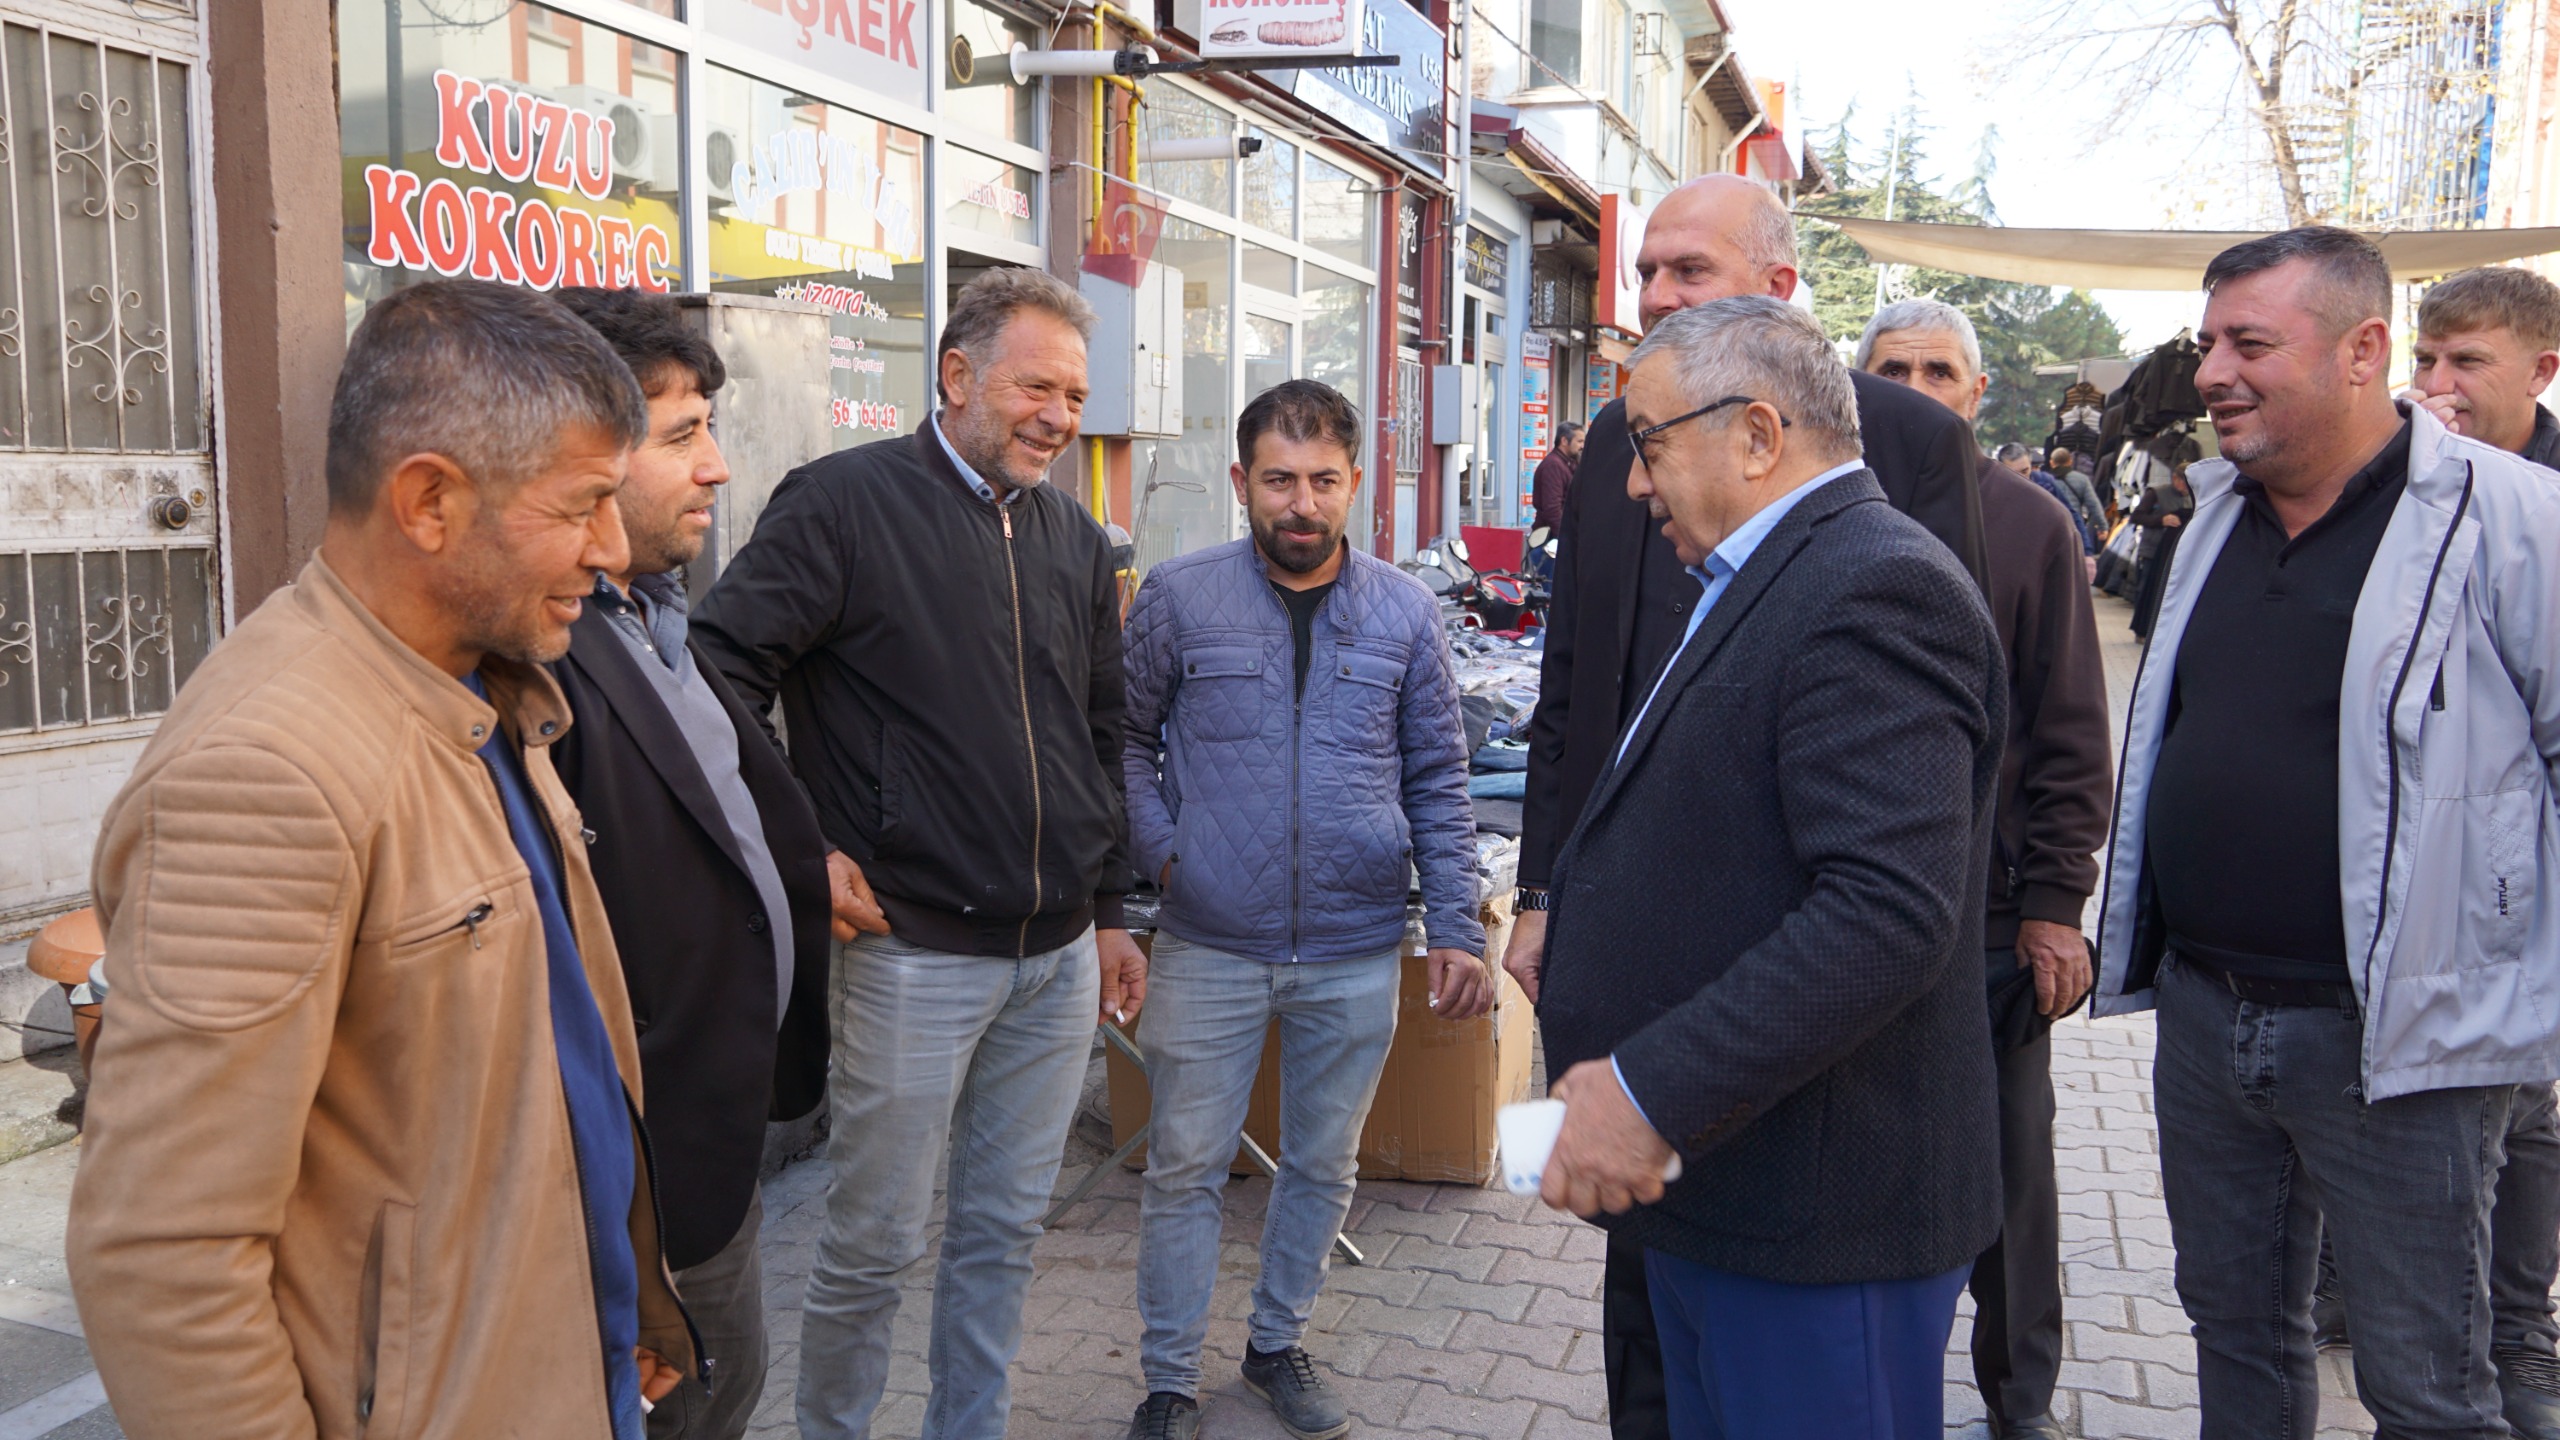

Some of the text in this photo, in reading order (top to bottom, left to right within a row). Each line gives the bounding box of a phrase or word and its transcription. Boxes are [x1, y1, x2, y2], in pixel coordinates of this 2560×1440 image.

[1362, 5, 1386, 56] AT
[1352, 66, 1414, 136] GELMİŞ
[434, 69, 615, 201] KUZU
[1000, 187, 1029, 219] USTA
[832, 335, 856, 351] Köfte
[860, 398, 878, 431] 64
[880, 403, 897, 432] 42
